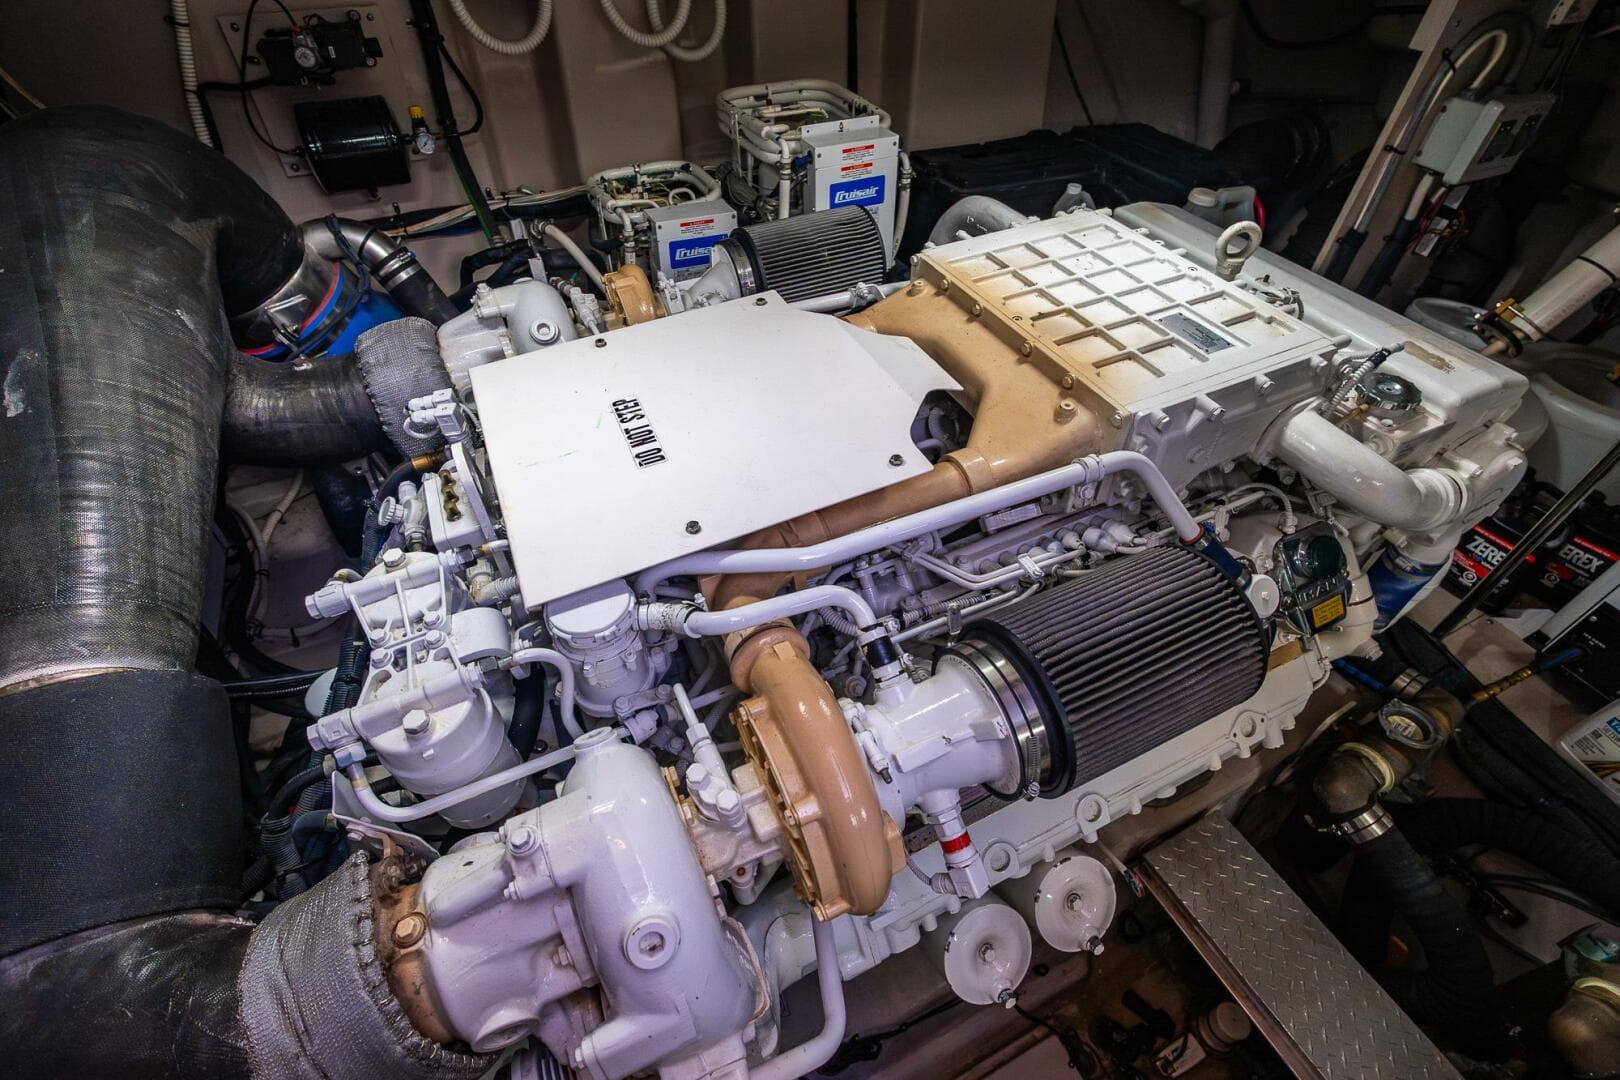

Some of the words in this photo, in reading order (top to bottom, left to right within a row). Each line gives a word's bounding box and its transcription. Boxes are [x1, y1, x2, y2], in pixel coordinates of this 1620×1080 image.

[834, 186, 879, 203] Cruisair
[612, 398, 645, 424] STEP
[623, 424, 657, 448] NOT
[634, 447, 666, 467] DO
[1465, 535, 1507, 565] ZERE
[1558, 543, 1605, 573] EREX
